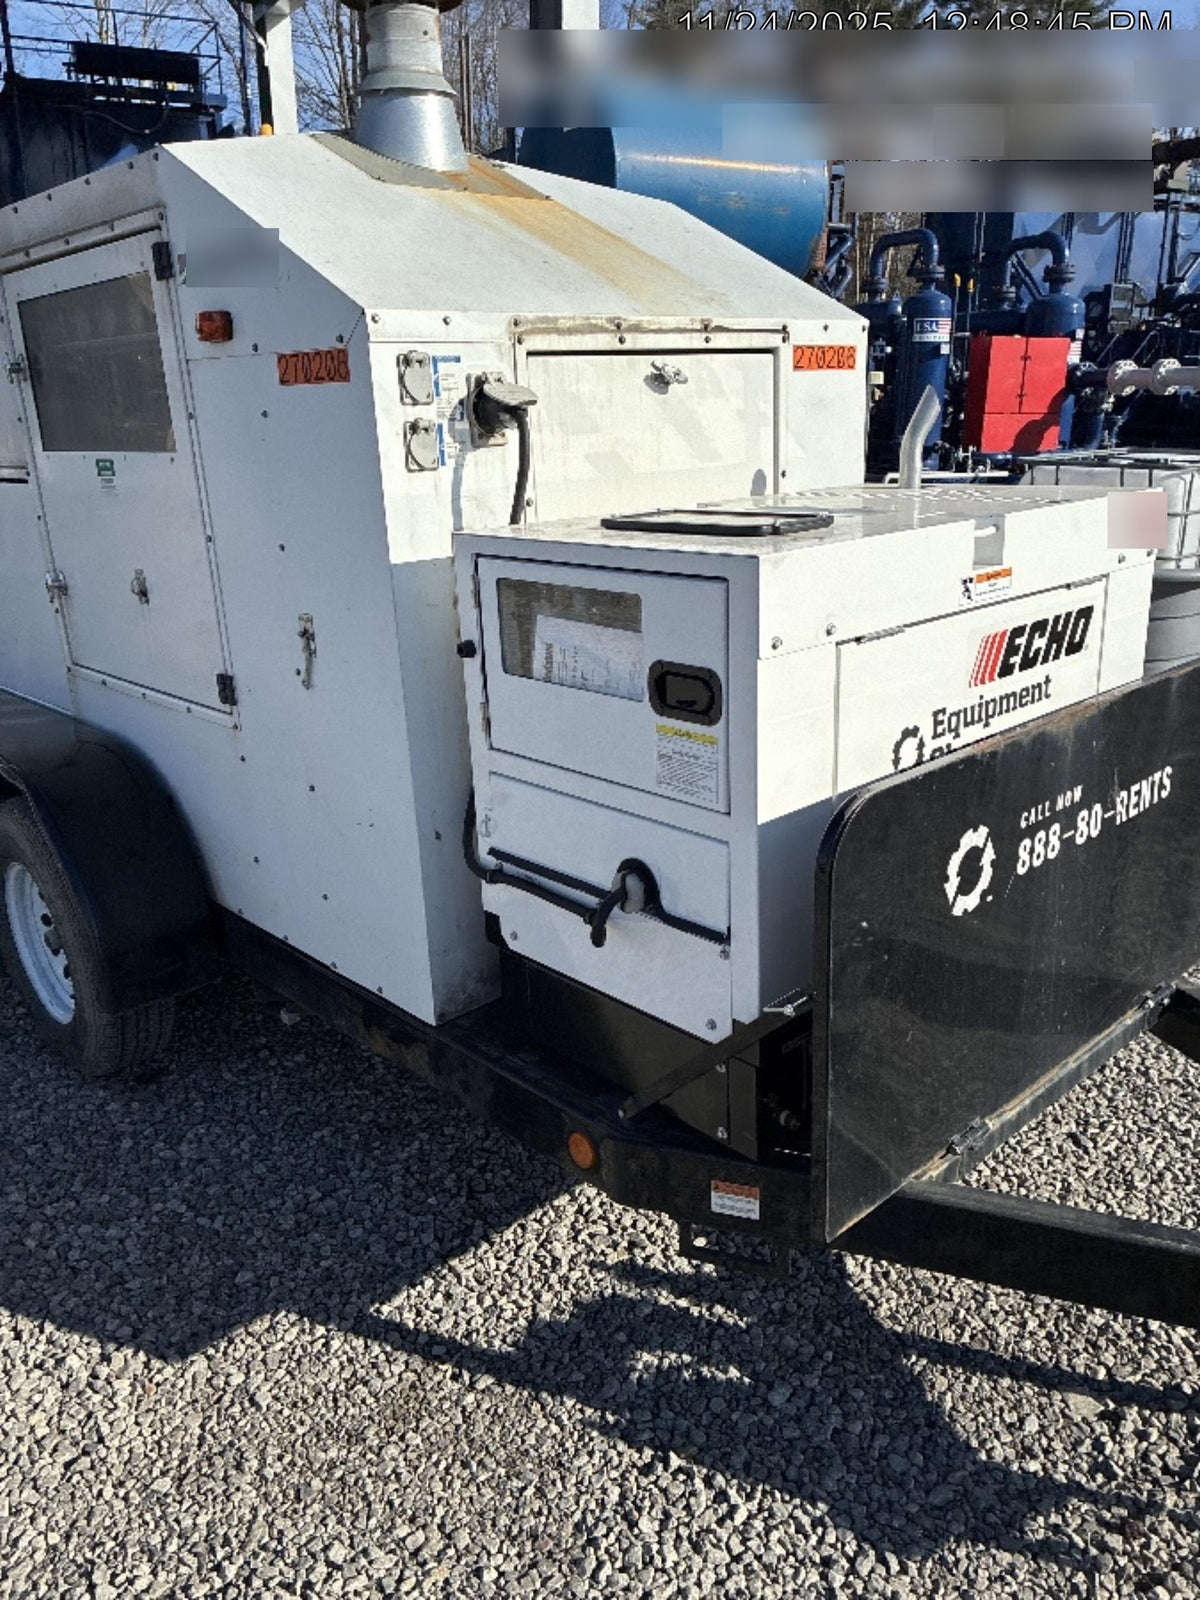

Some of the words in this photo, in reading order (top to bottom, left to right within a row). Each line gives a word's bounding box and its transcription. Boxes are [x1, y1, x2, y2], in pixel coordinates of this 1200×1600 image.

[997, 604, 1094, 679] ECHO
[931, 674, 1052, 740] Equipment
[1016, 765, 1173, 875] 888-80-RENTS
[1020, 800, 1051, 829] CALL
[1055, 784, 1083, 811] NOW
